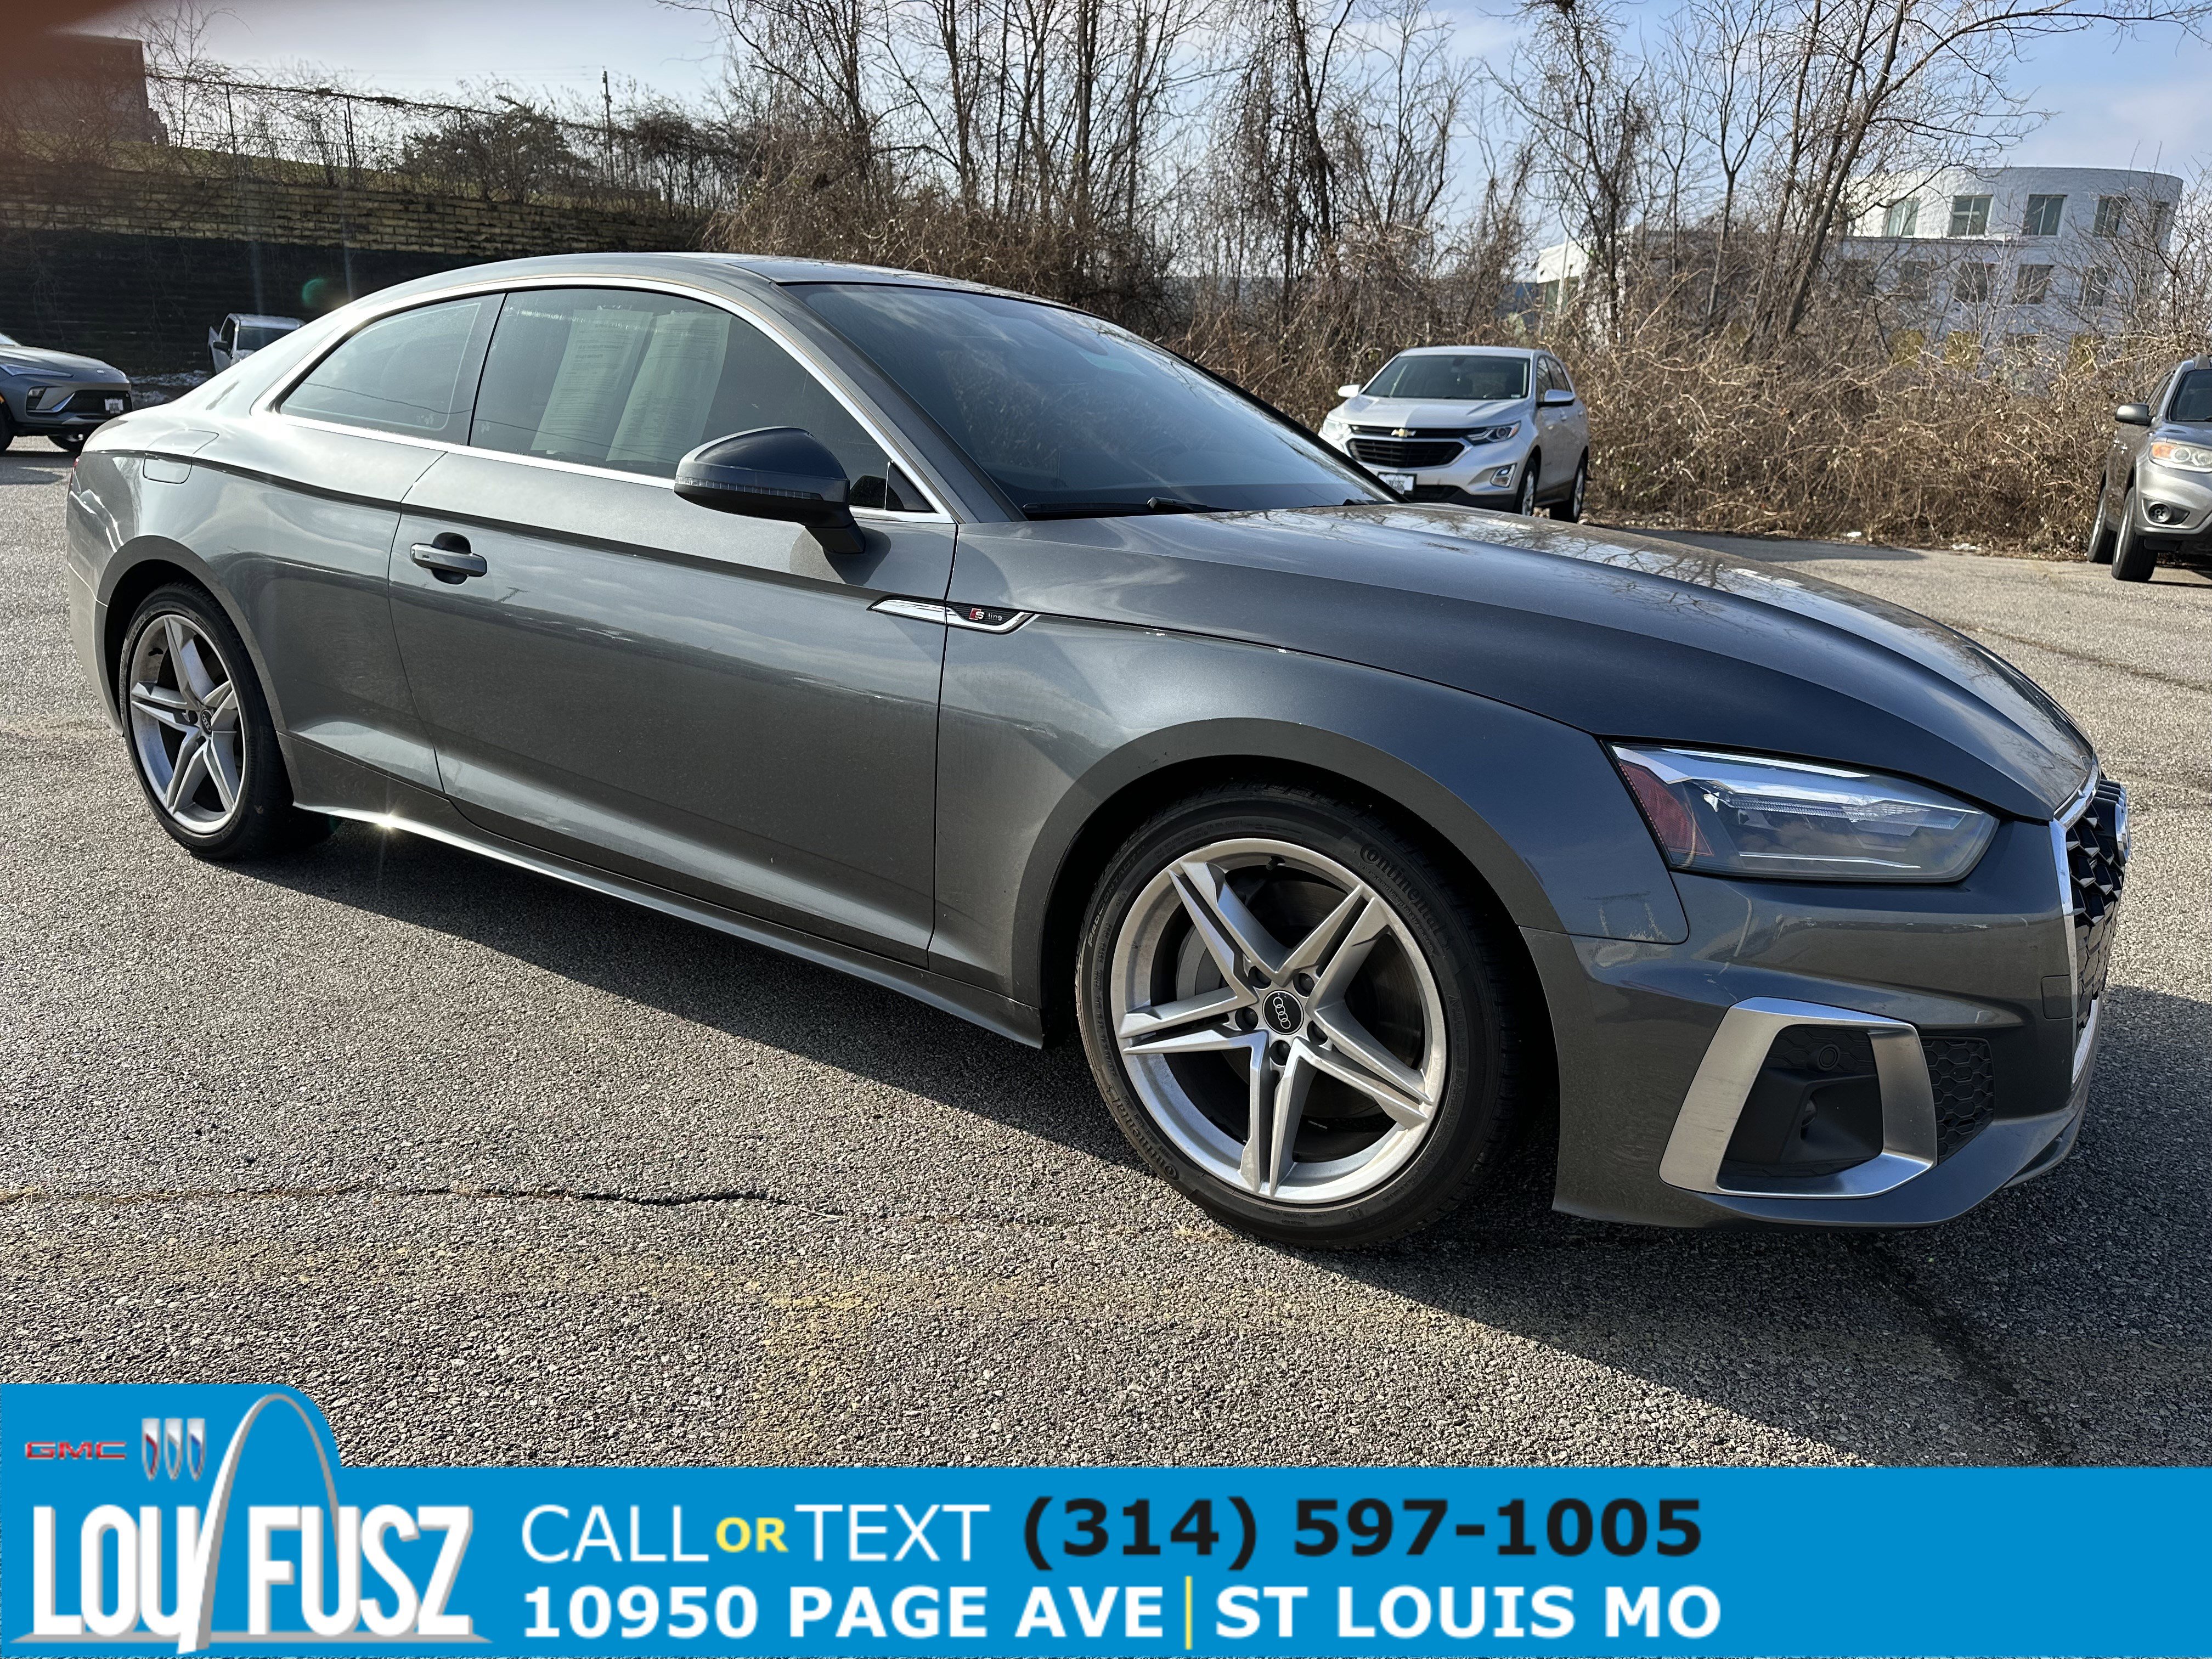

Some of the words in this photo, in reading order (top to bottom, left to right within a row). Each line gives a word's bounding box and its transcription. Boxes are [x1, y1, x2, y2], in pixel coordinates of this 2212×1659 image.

[988, 612, 1002, 621] line
[1360, 843, 1447, 936] Continental
[1111, 1097, 1181, 1182] Continental
